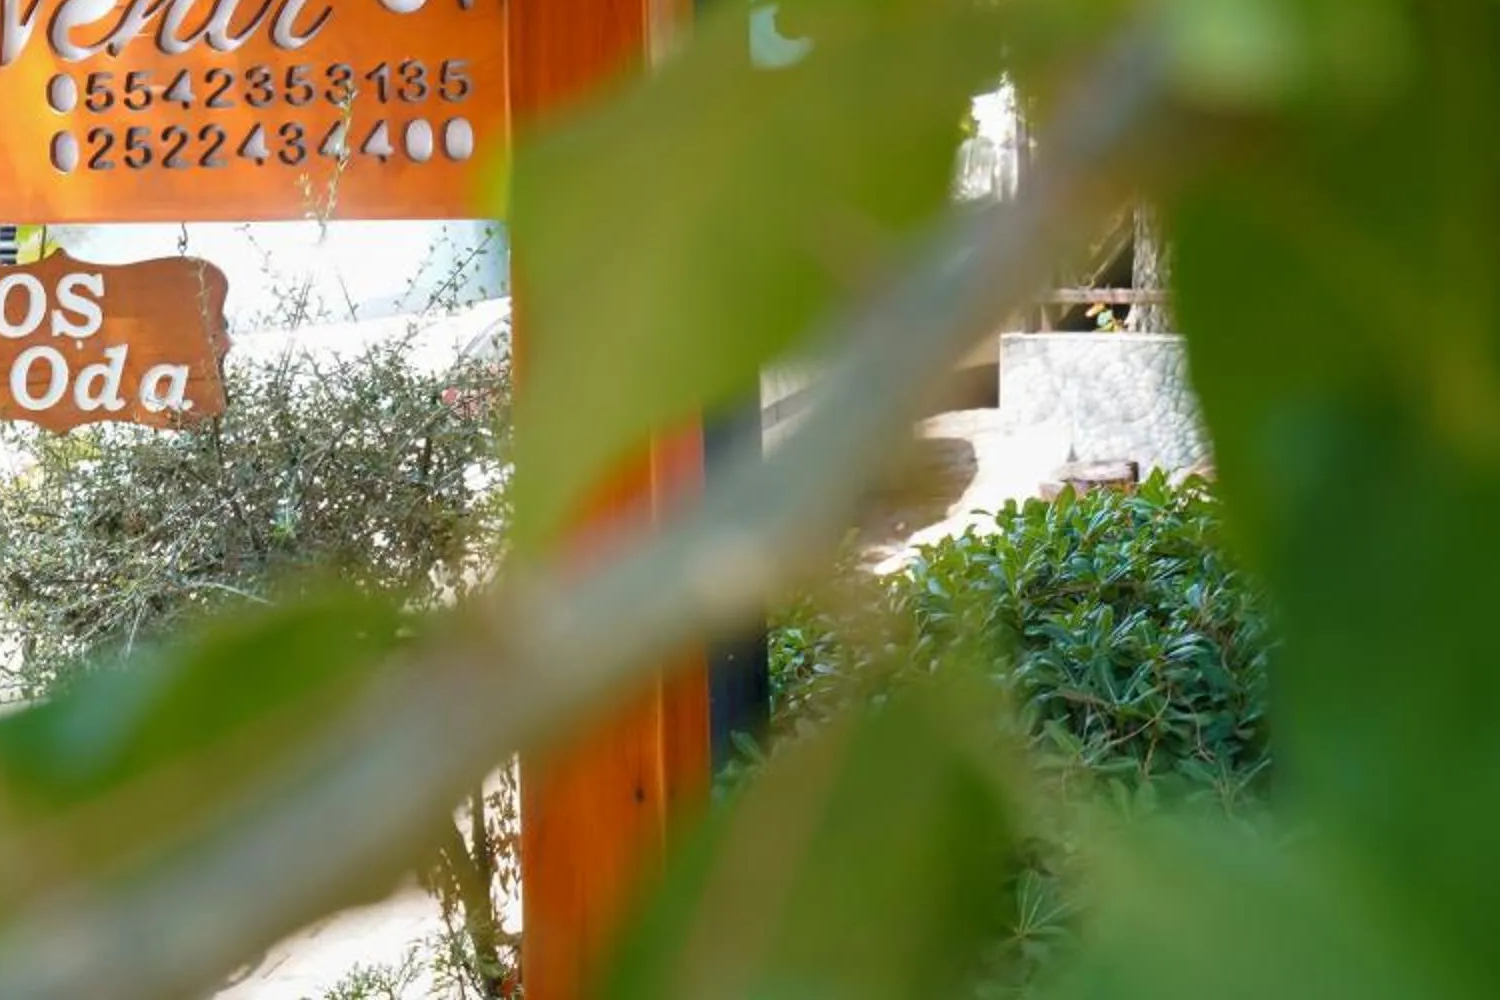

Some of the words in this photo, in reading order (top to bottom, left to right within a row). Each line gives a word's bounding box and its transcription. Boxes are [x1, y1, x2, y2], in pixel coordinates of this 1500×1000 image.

[46, 59, 475, 115] 05542353135
[49, 116, 475, 174] 02522434400
[9, 343, 193, 413] Oda
